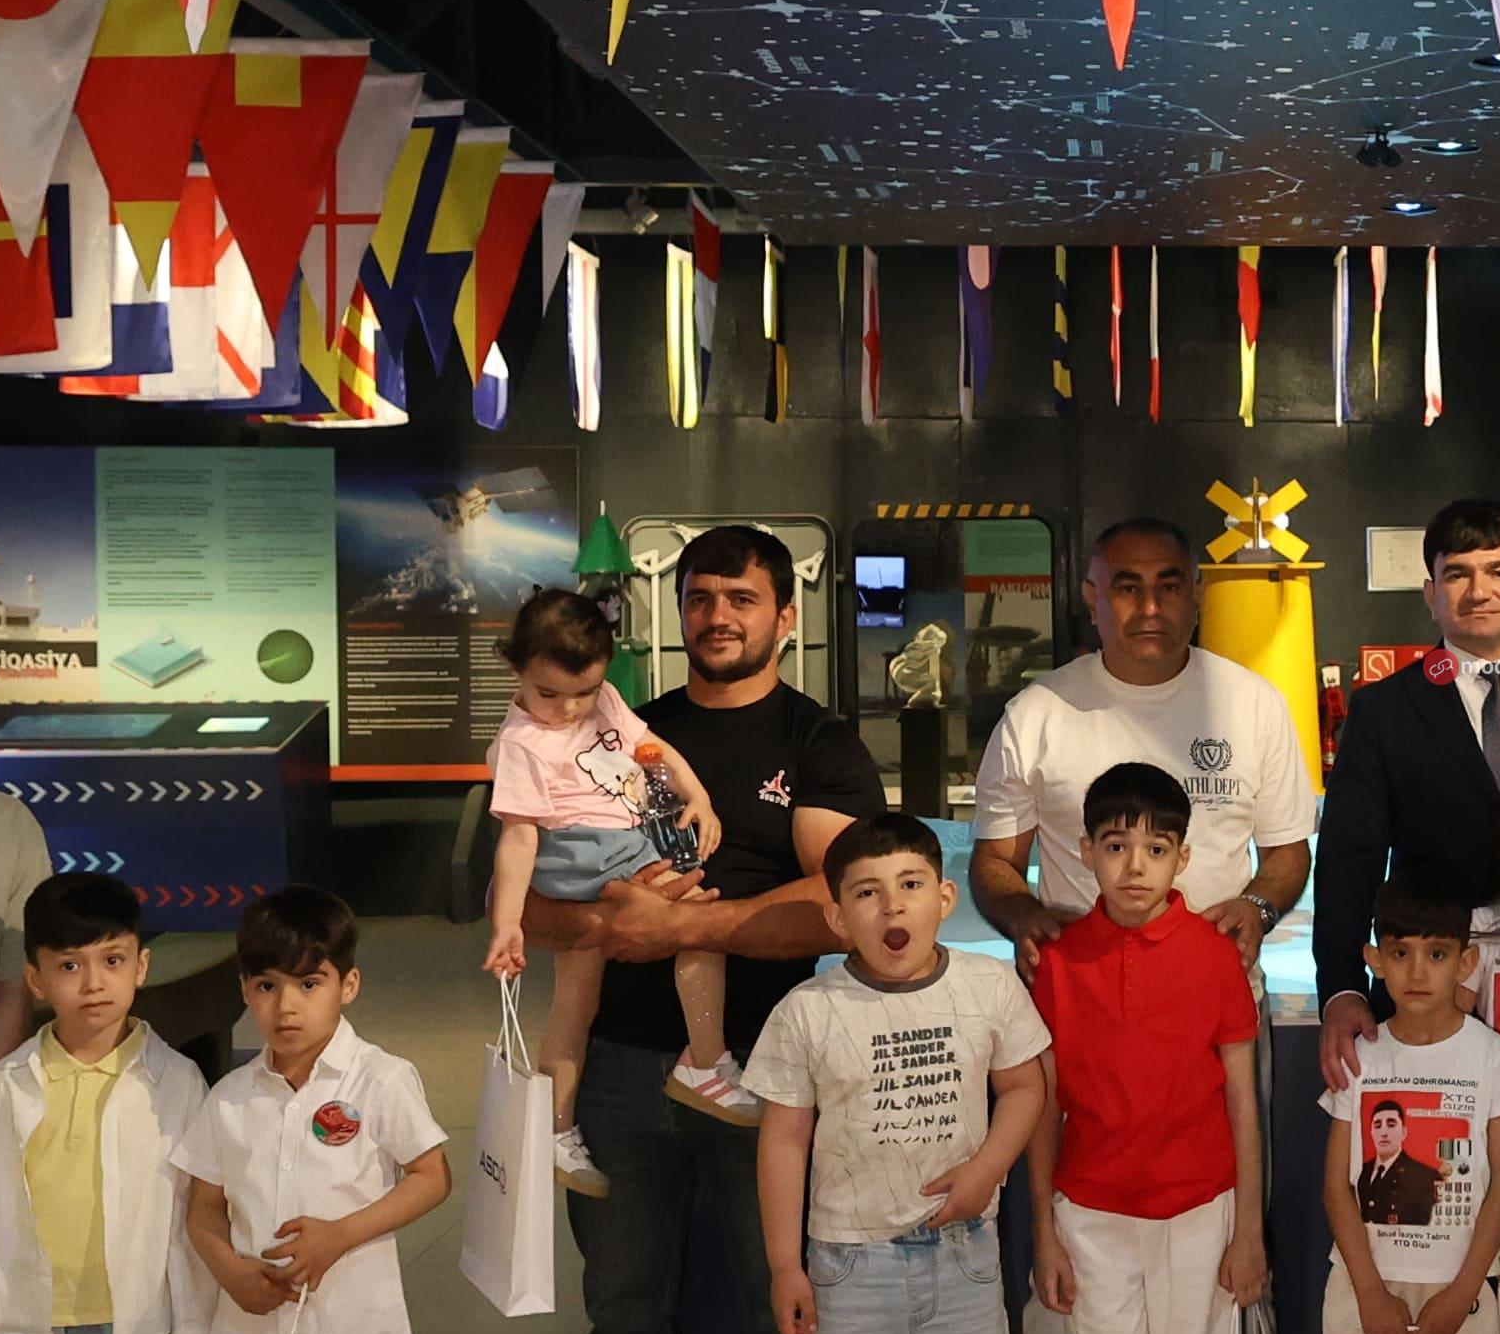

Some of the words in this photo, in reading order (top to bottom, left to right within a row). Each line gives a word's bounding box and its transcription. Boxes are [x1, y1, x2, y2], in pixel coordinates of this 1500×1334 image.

[1205, 748, 1218, 762] V
[1215, 777, 1240, 796] DEPT
[871, 1034, 891, 1047] JIL
[891, 1027, 953, 1045] SANDER
[872, 1048, 891, 1061] JIL
[892, 1041, 946, 1058] SANDER
[873, 1061, 896, 1074] JIL
[901, 1051, 957, 1069] SANDER
[873, 1078, 899, 1093] JIL
[902, 1068, 962, 1089] SANDER
[1443, 1092, 1476, 1104] XTQ
